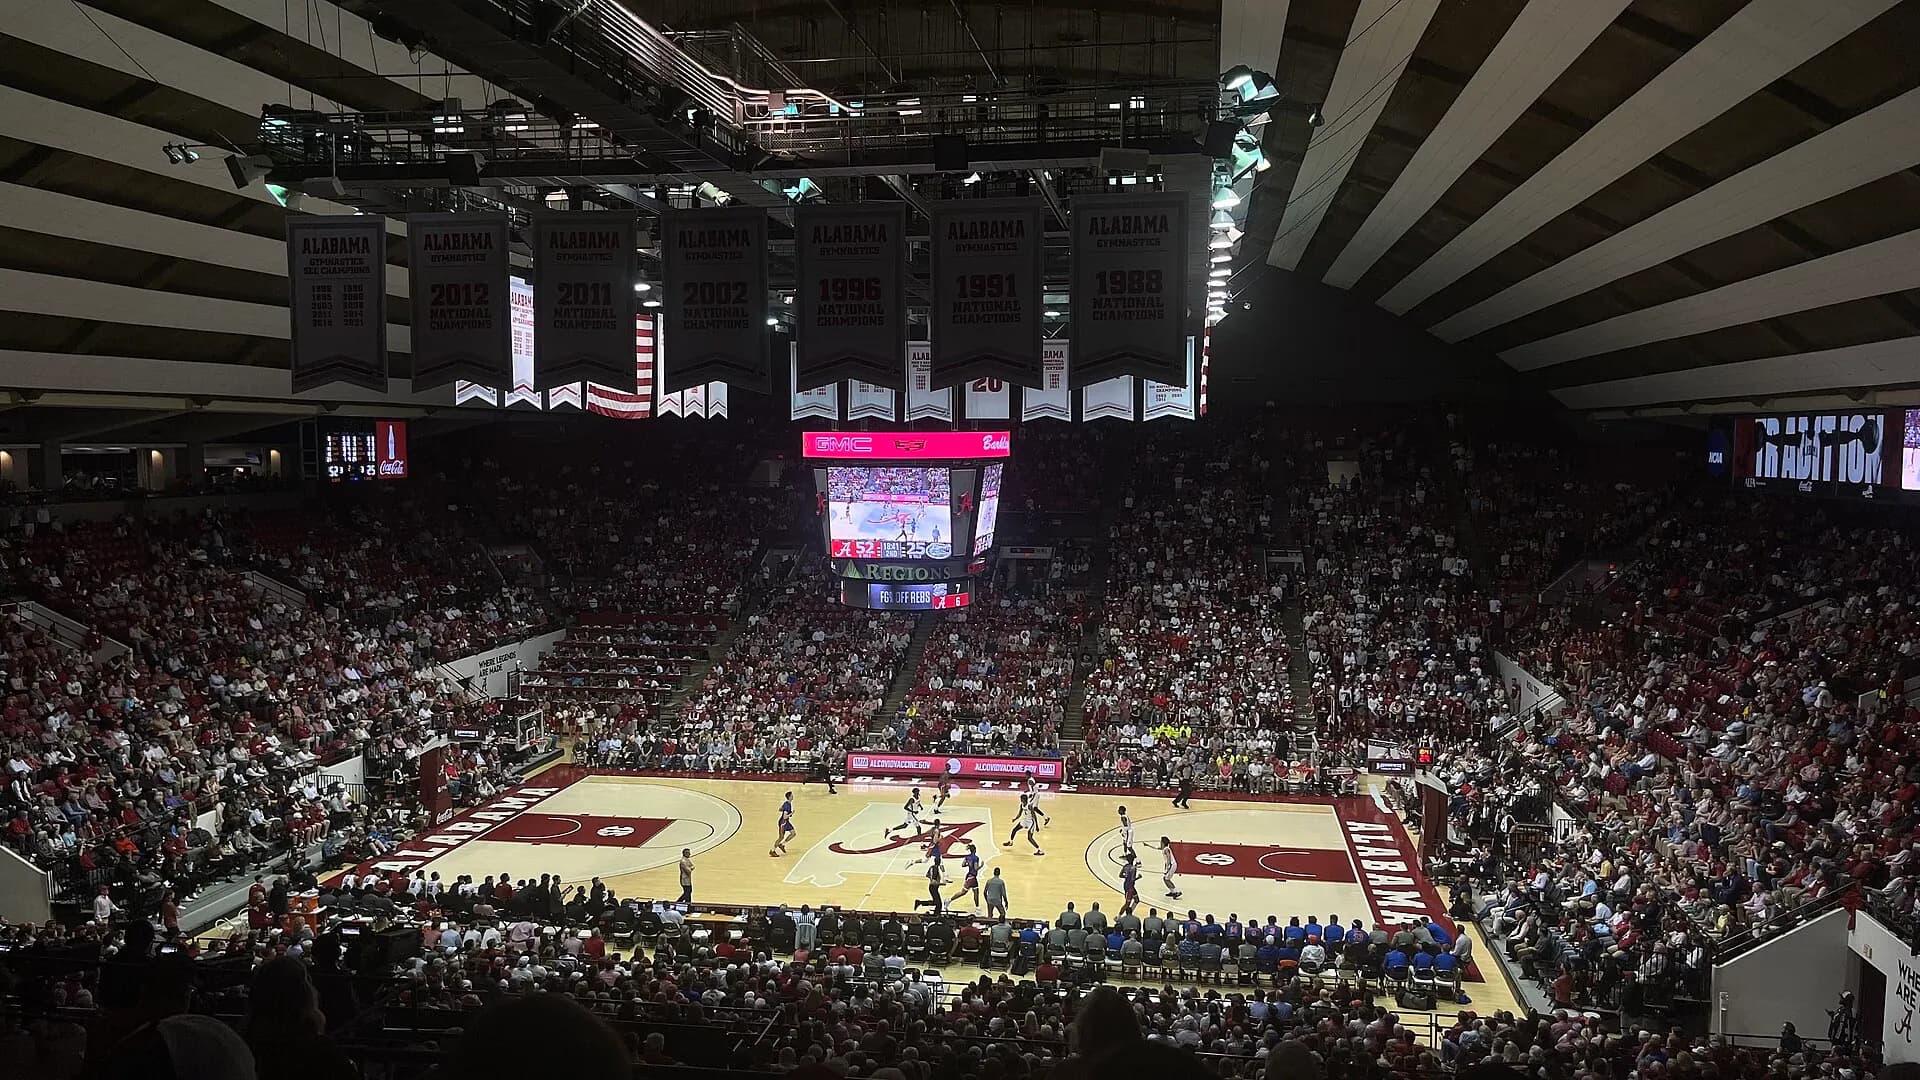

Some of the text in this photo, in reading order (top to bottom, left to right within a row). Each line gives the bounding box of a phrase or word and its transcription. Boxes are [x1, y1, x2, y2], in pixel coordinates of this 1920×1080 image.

[812, 223, 887, 243] ALABAMA
[947, 220, 1025, 240] ALABAMA
[1089, 215, 1169, 236] ALABAMA
[302, 237, 370, 254] ALABAMA
[424, 232, 493, 250] ALABAMA
[549, 231, 620, 249] ALABAMA
[678, 229, 750, 248] ALABAMA
[819, 277, 881, 301] 1996
[956, 274, 1016, 298] 1991
[1095, 270, 1163, 295] 1988
[430, 283, 488, 306] 2012
[558, 283, 612, 306] 2011
[683, 282, 748, 305] 2002
[817, 304, 884, 315] NATIONAL
[952, 301, 1021, 313] NATIONAL
[1092, 297, 1164, 309] NATIONAL
[430, 308, 491, 319] NATIONAL
[554, 308, 616, 319] NATIONAL
[683, 307, 748, 318] NATIONAL
[952, 313, 1021, 324] CHAMPIONS
[1092, 310, 1164, 321] CHAMPIONS
[430, 320, 491, 330] CHAMPIONS
[554, 320, 616, 330] CHAMPIONS
[683, 319, 748, 329] CHAMPIONS
[817, 316, 884, 326] CHAMPIONS
[815, 437, 873, 452] GMC
[1755, 414, 1885, 484] TRADITION
[1708, 451, 1723, 464] NCAA
[379, 460, 404, 475] Coca-Cola
[856, 542, 875, 554] 52
[907, 542, 926, 555] 25
[866, 563, 952, 580] REGIONS
[955, 584, 961, 593] 7
[910, 591, 931, 604] REBS
[955, 597, 961, 606] 6
[478, 651, 517, 668] WHERE LEGENDS
[479, 663, 503, 678] ARE MADE
[979, 780, 1078, 792] TIDE
[370, 787, 560, 872] ALABAMA
[1345, 820, 1433, 925] ALABAMA
[1897, 959, 1920, 993] WHE
[1895, 981, 1917, 1010] ARE
